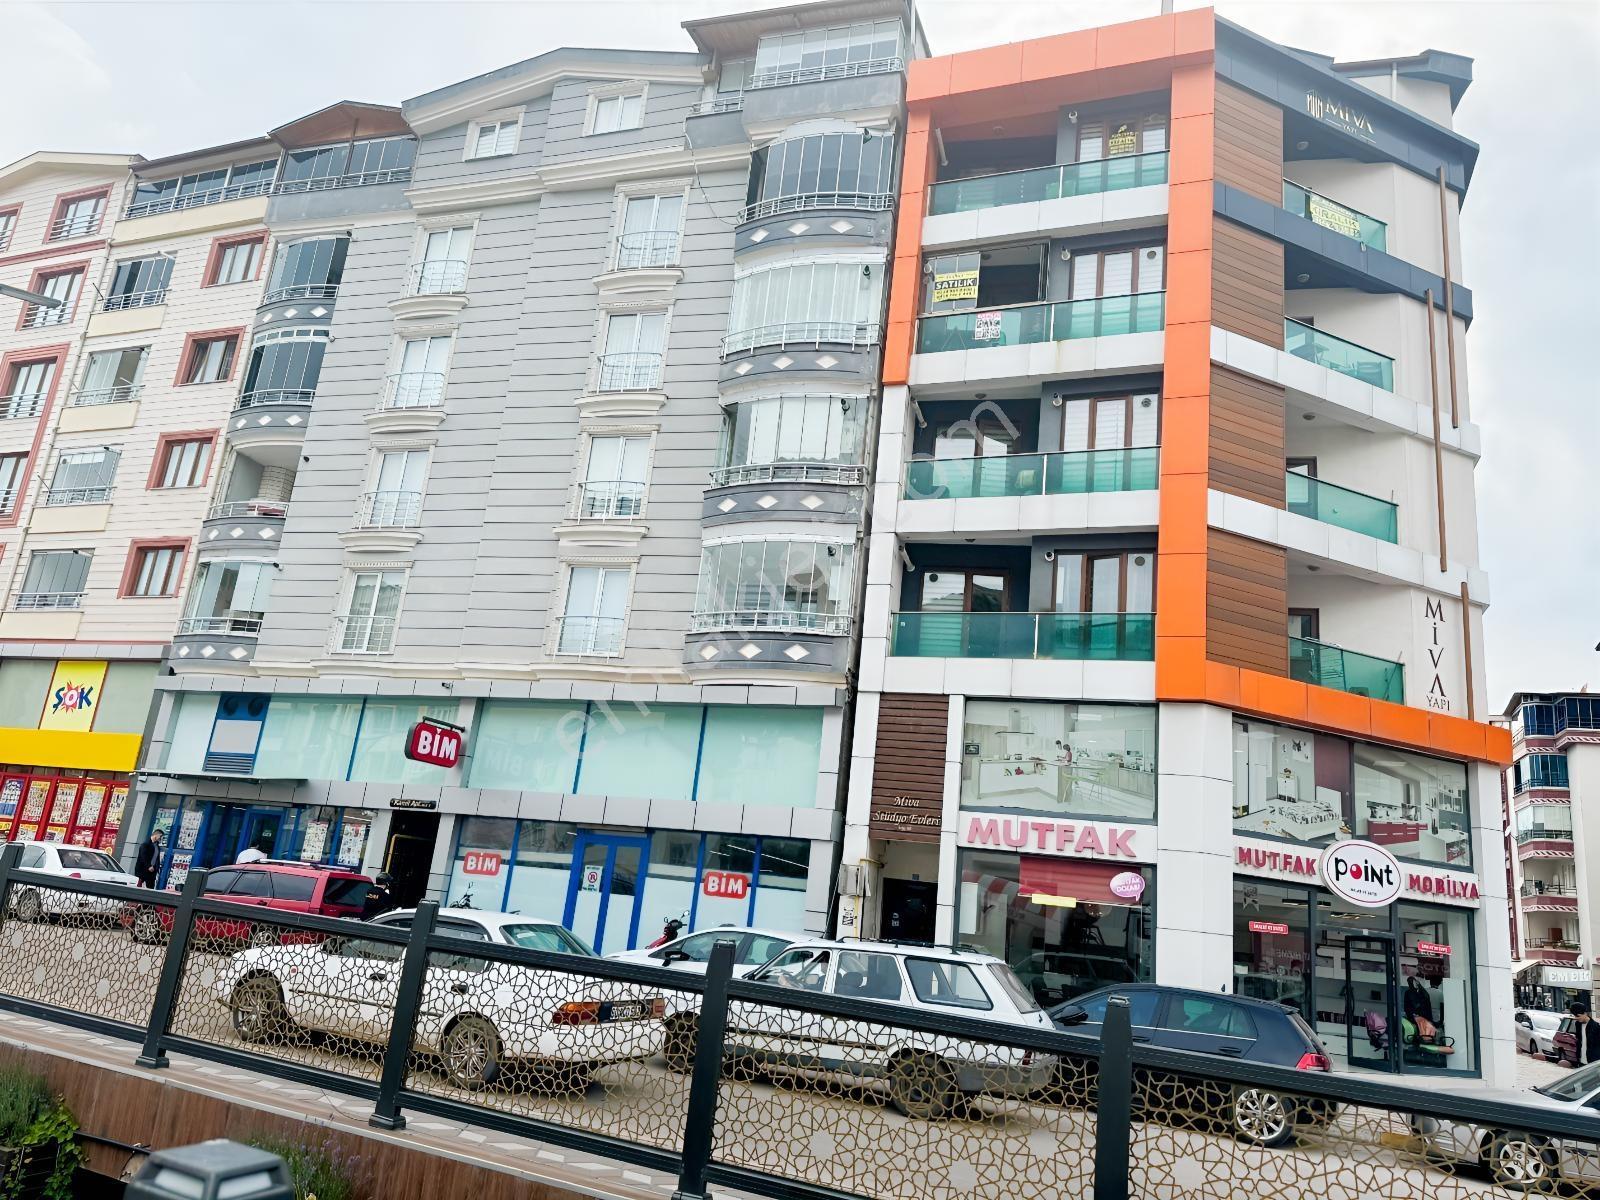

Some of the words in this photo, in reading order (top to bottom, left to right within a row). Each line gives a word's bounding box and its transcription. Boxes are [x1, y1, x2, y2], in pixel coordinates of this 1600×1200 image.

[935, 278, 974, 290] SATILIK
[1426, 695, 1451, 711] YAPI
[417, 728, 457, 761] BİM
[893, 795, 920, 807] Miva
[967, 817, 1137, 858] MUTFAK
[466, 852, 497, 872] BİM
[708, 873, 744, 895] BİM
[1238, 847, 1317, 876] MUTFAK
[1406, 873, 1480, 900] MOBİLYA
